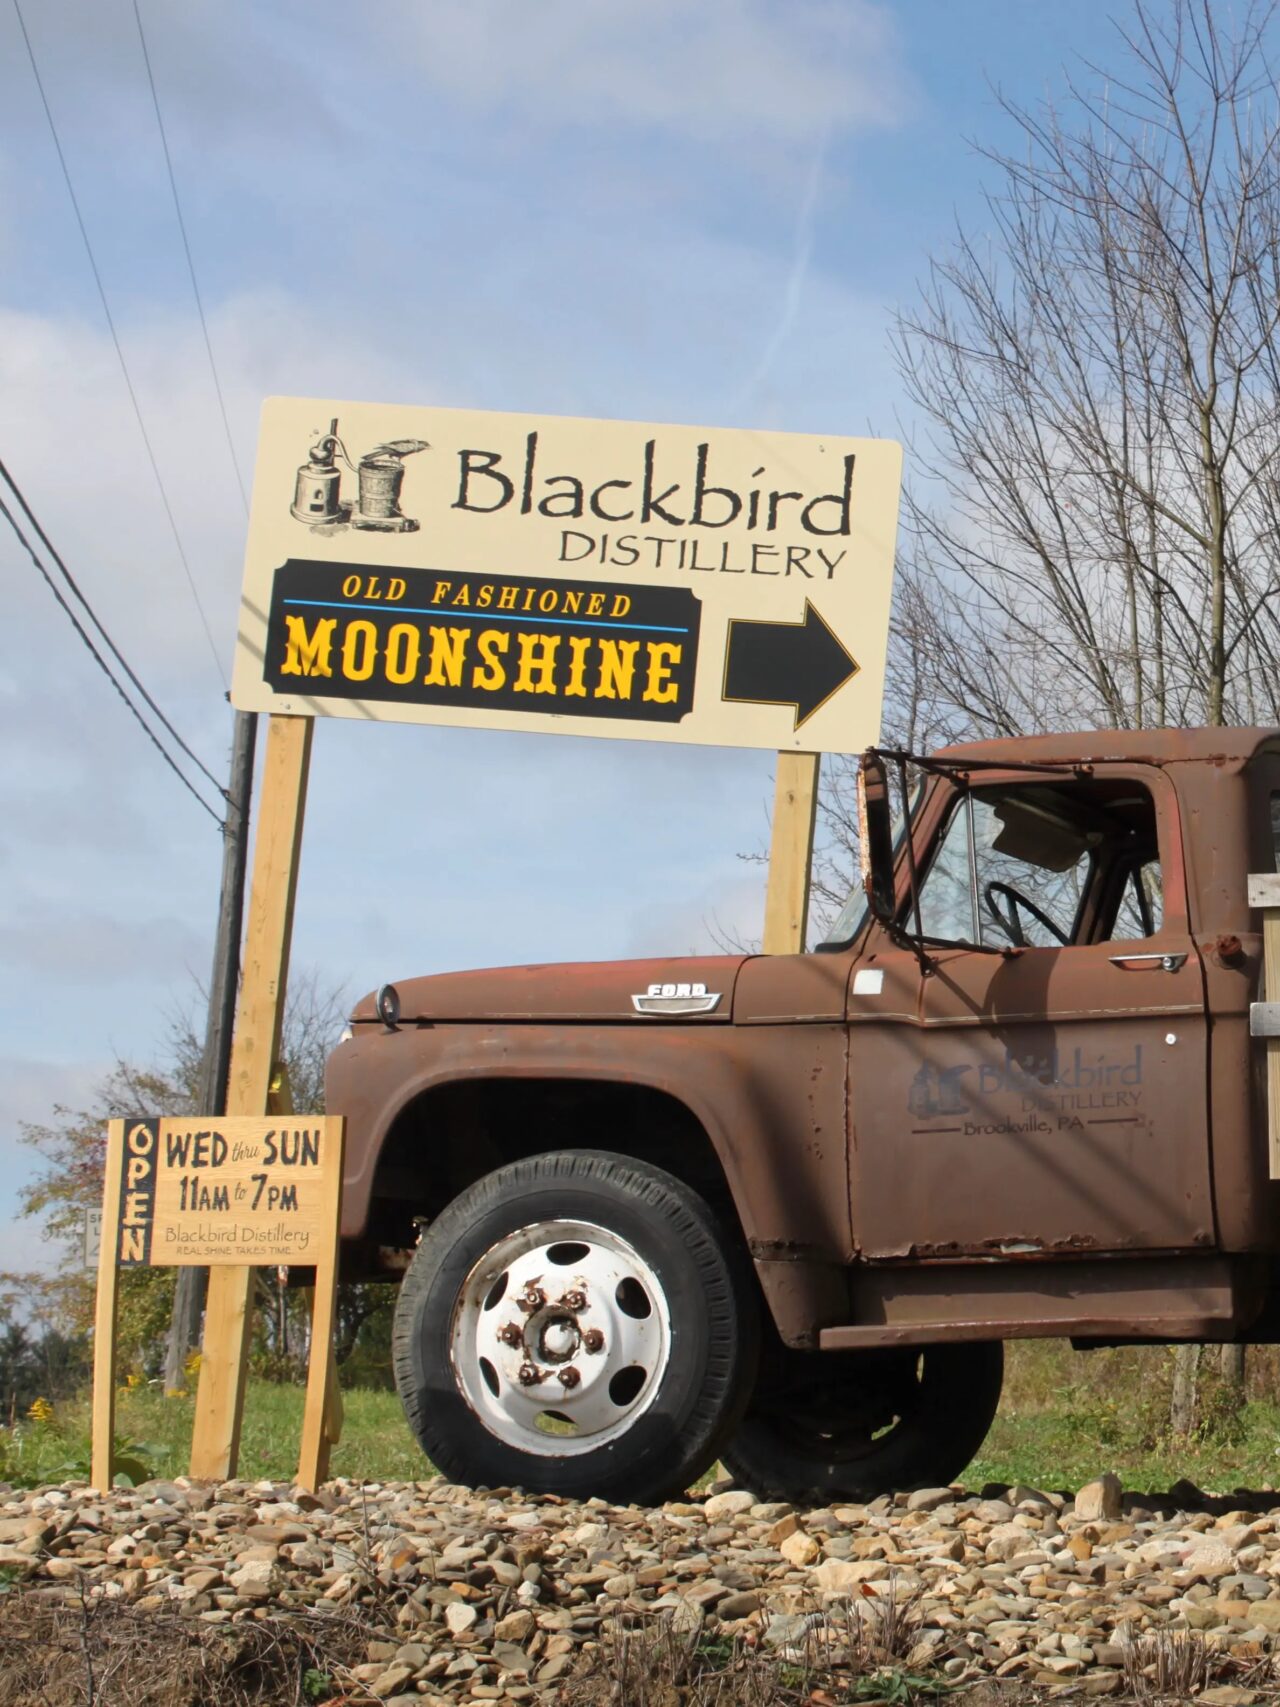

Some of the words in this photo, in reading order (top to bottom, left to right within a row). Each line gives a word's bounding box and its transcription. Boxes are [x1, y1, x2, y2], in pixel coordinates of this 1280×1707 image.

[451, 431, 855, 537] Blackbird
[558, 531, 847, 580] DISTILLERY
[342, 575, 407, 601] OLD
[432, 582, 631, 617] FASHIONED
[280, 615, 683, 704] MOONSHINE
[648, 983, 707, 997] FORD
[1021, 1091, 1143, 1113] DISTILLERY
[963, 1116, 1052, 1136] Brookville,
[1057, 1116, 1085, 1131] PA
[166, 1131, 228, 1168] WED
[232, 1141, 260, 1162] thru
[263, 1130, 320, 1166] SUN
[121, 1123, 153, 1261] OPEN
[180, 1175, 230, 1211] 11AM
[235, 1182, 248, 1200] to
[165, 1223, 237, 1243] Blackbird
[242, 1223, 310, 1250] Distillery
[176, 1246, 202, 1256] REAL
[205, 1246, 232, 1255] SHINE
[235, 1246, 267, 1255] TAKES
